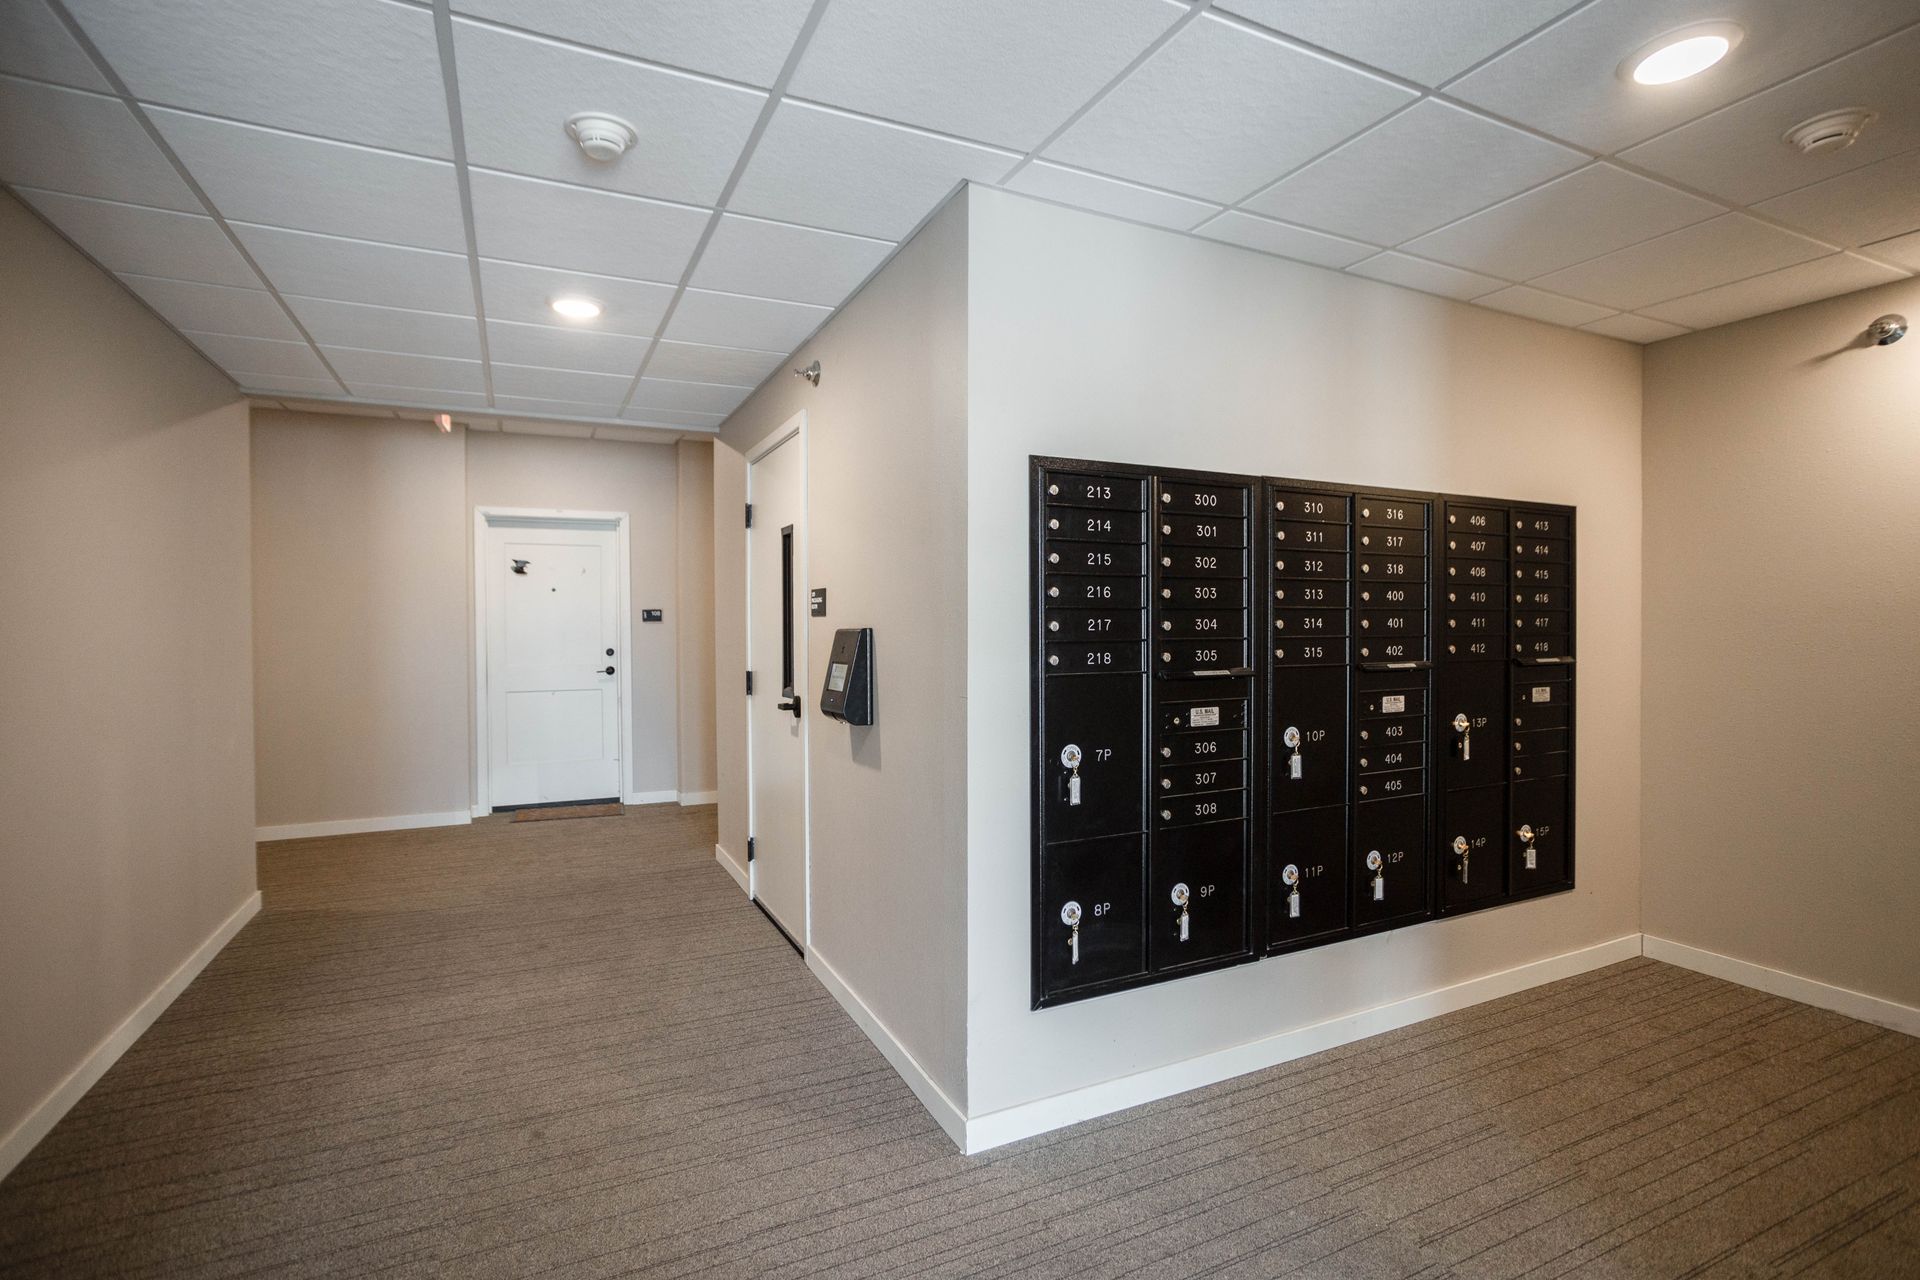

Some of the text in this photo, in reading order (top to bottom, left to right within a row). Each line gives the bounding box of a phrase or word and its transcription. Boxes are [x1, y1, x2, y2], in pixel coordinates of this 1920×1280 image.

[1086, 486, 1111, 500] 213
[1194, 494, 1217, 507] 300
[1304, 502, 1324, 514] 310
[1386, 509, 1404, 521] 316
[1087, 519, 1112, 532] 214
[1469, 516, 1486, 527] 406
[1196, 525, 1217, 537] 301
[1305, 531, 1323, 543] 311
[1386, 536, 1404, 547] 317
[1470, 541, 1486, 552] 407
[1534, 545, 1549, 555] 414
[1087, 553, 1112, 566] 215
[1194, 557, 1217, 569] 302
[1304, 561, 1323, 572] 312
[1386, 564, 1404, 575] 318
[1469, 567, 1486, 578] 408
[1086, 586, 1112, 599] 216
[1194, 588, 1217, 599] 303
[1304, 589, 1324, 600] 313
[1386, 591, 1405, 601] 400
[1470, 593, 1486, 603] 410
[1087, 619, 1112, 632] 217
[1195, 619, 1218, 631] 304
[1303, 618, 1323, 629] 314
[1387, 618, 1404, 629] 401
[1471, 618, 1485, 628] 411
[1534, 618, 1549, 627] 417
[1303, 647, 1323, 658] 315
[1385, 646, 1403, 656] 402
[1470, 644, 1486, 654] 412
[1087, 653, 1112, 665] 218
[1195, 650, 1218, 662] 305
[1472, 718, 1488, 728] 13P
[1306, 730, 1326, 742] 10P
[1385, 726, 1403, 737] 403
[1194, 742, 1217, 754] 306
[1095, 749, 1112, 762] 7P
[1384, 753, 1403, 764] 404
[1195, 772, 1217, 785] 307
[1384, 780, 1402, 791] 405
[1194, 803, 1217, 816] 308
[1471, 837, 1487, 849] 14P
[1387, 852, 1404, 864] 12P
[1304, 866, 1324, 878] 11P
[1200, 885, 1215, 898] 9P
[1094, 903, 1111, 917] 8P
